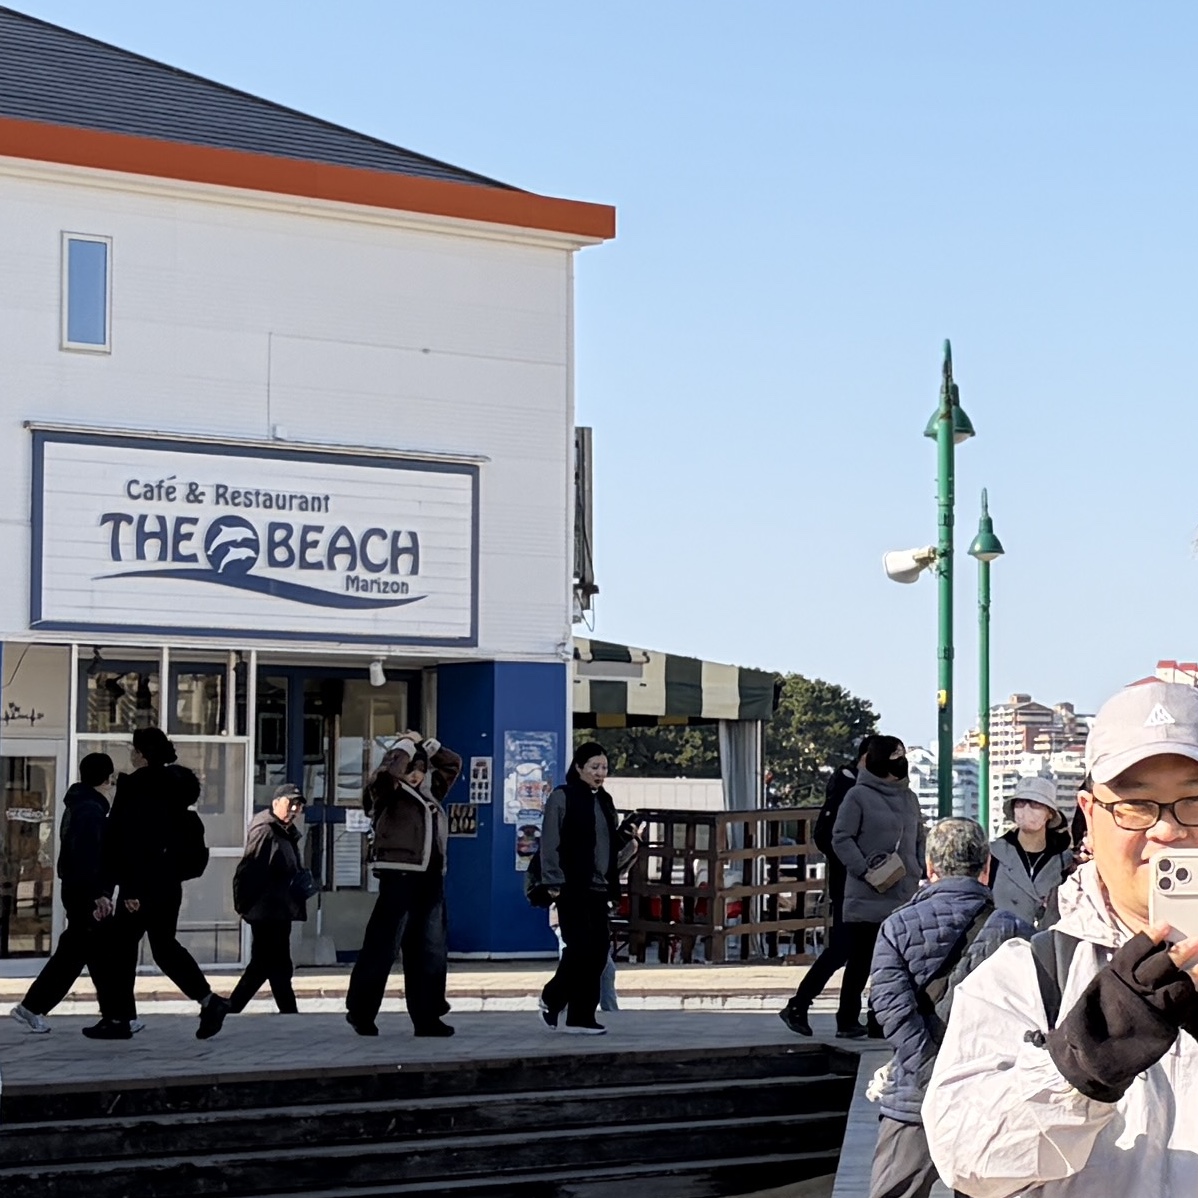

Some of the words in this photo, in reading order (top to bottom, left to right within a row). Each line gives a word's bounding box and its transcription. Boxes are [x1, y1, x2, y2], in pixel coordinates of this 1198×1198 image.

[126, 475, 177, 503] Café
[186, 481, 206, 504] &
[215, 484, 330, 513] Restaurant
[100, 512, 200, 563] THE
[267, 521, 420, 576] BEACH
[345, 575, 410, 594] Marizon
